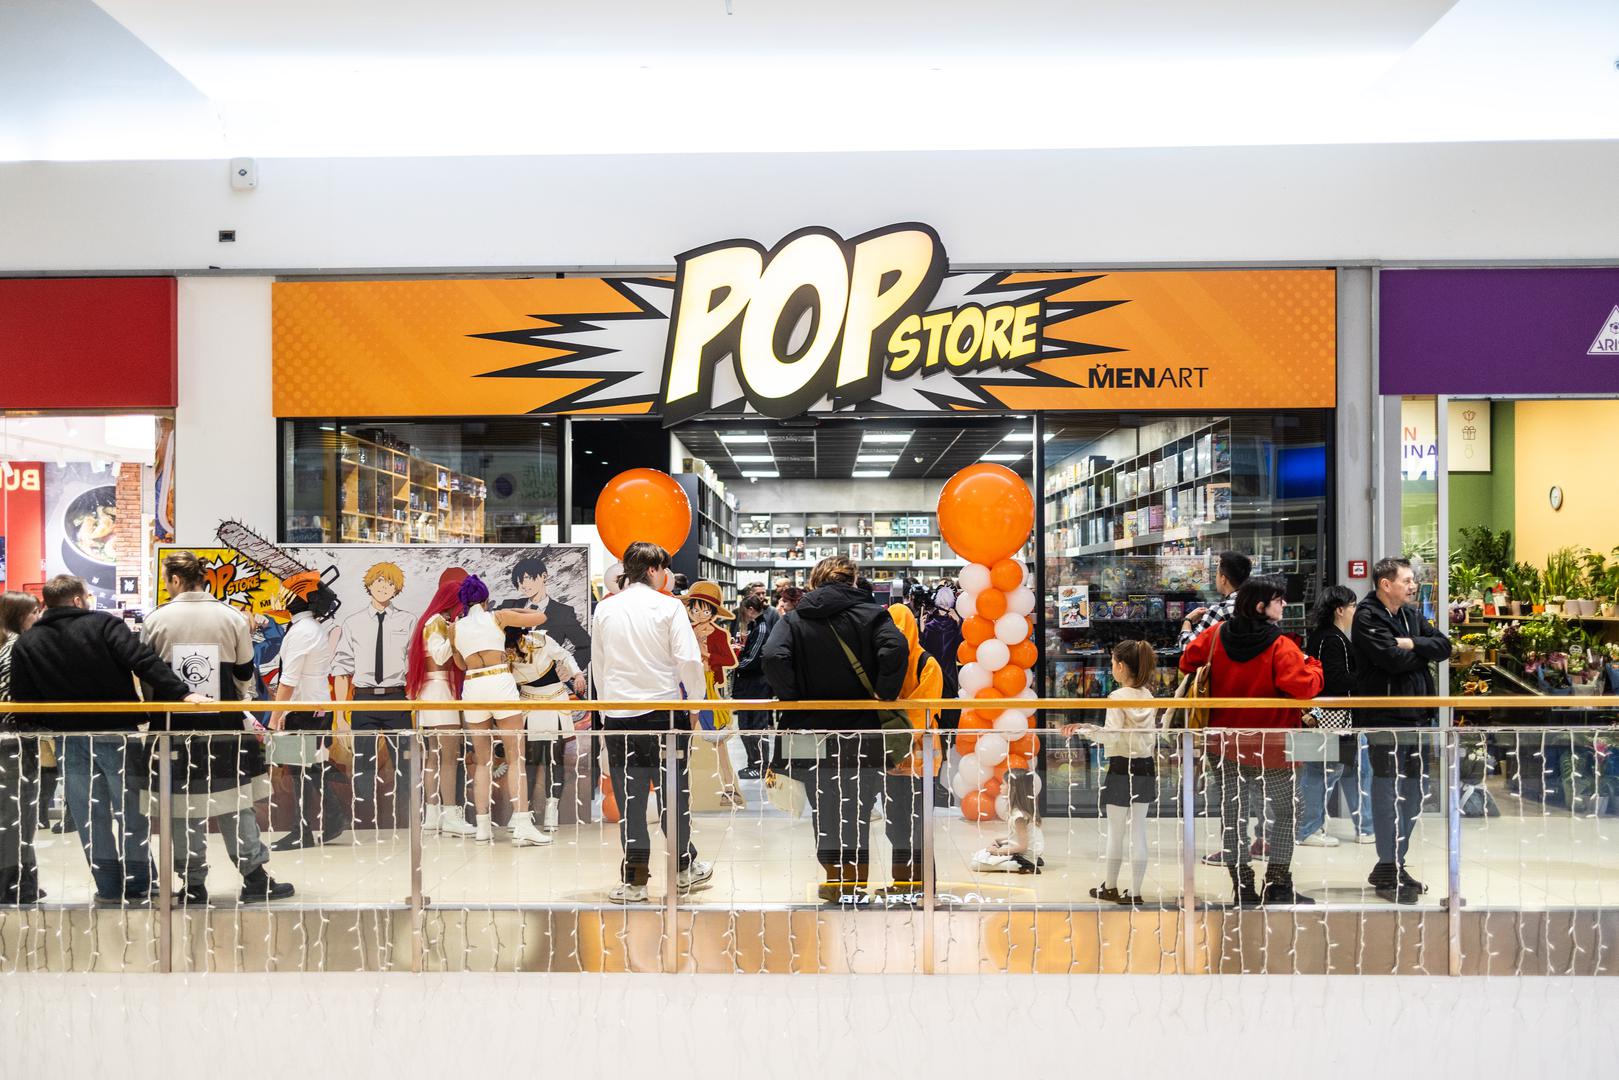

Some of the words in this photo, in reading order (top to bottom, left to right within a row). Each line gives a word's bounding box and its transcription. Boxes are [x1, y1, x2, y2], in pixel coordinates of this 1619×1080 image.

[664, 228, 935, 404] POP
[887, 302, 1041, 372] STORE
[1596, 338, 1619, 351] ARI
[1088, 366, 1209, 388] MENART
